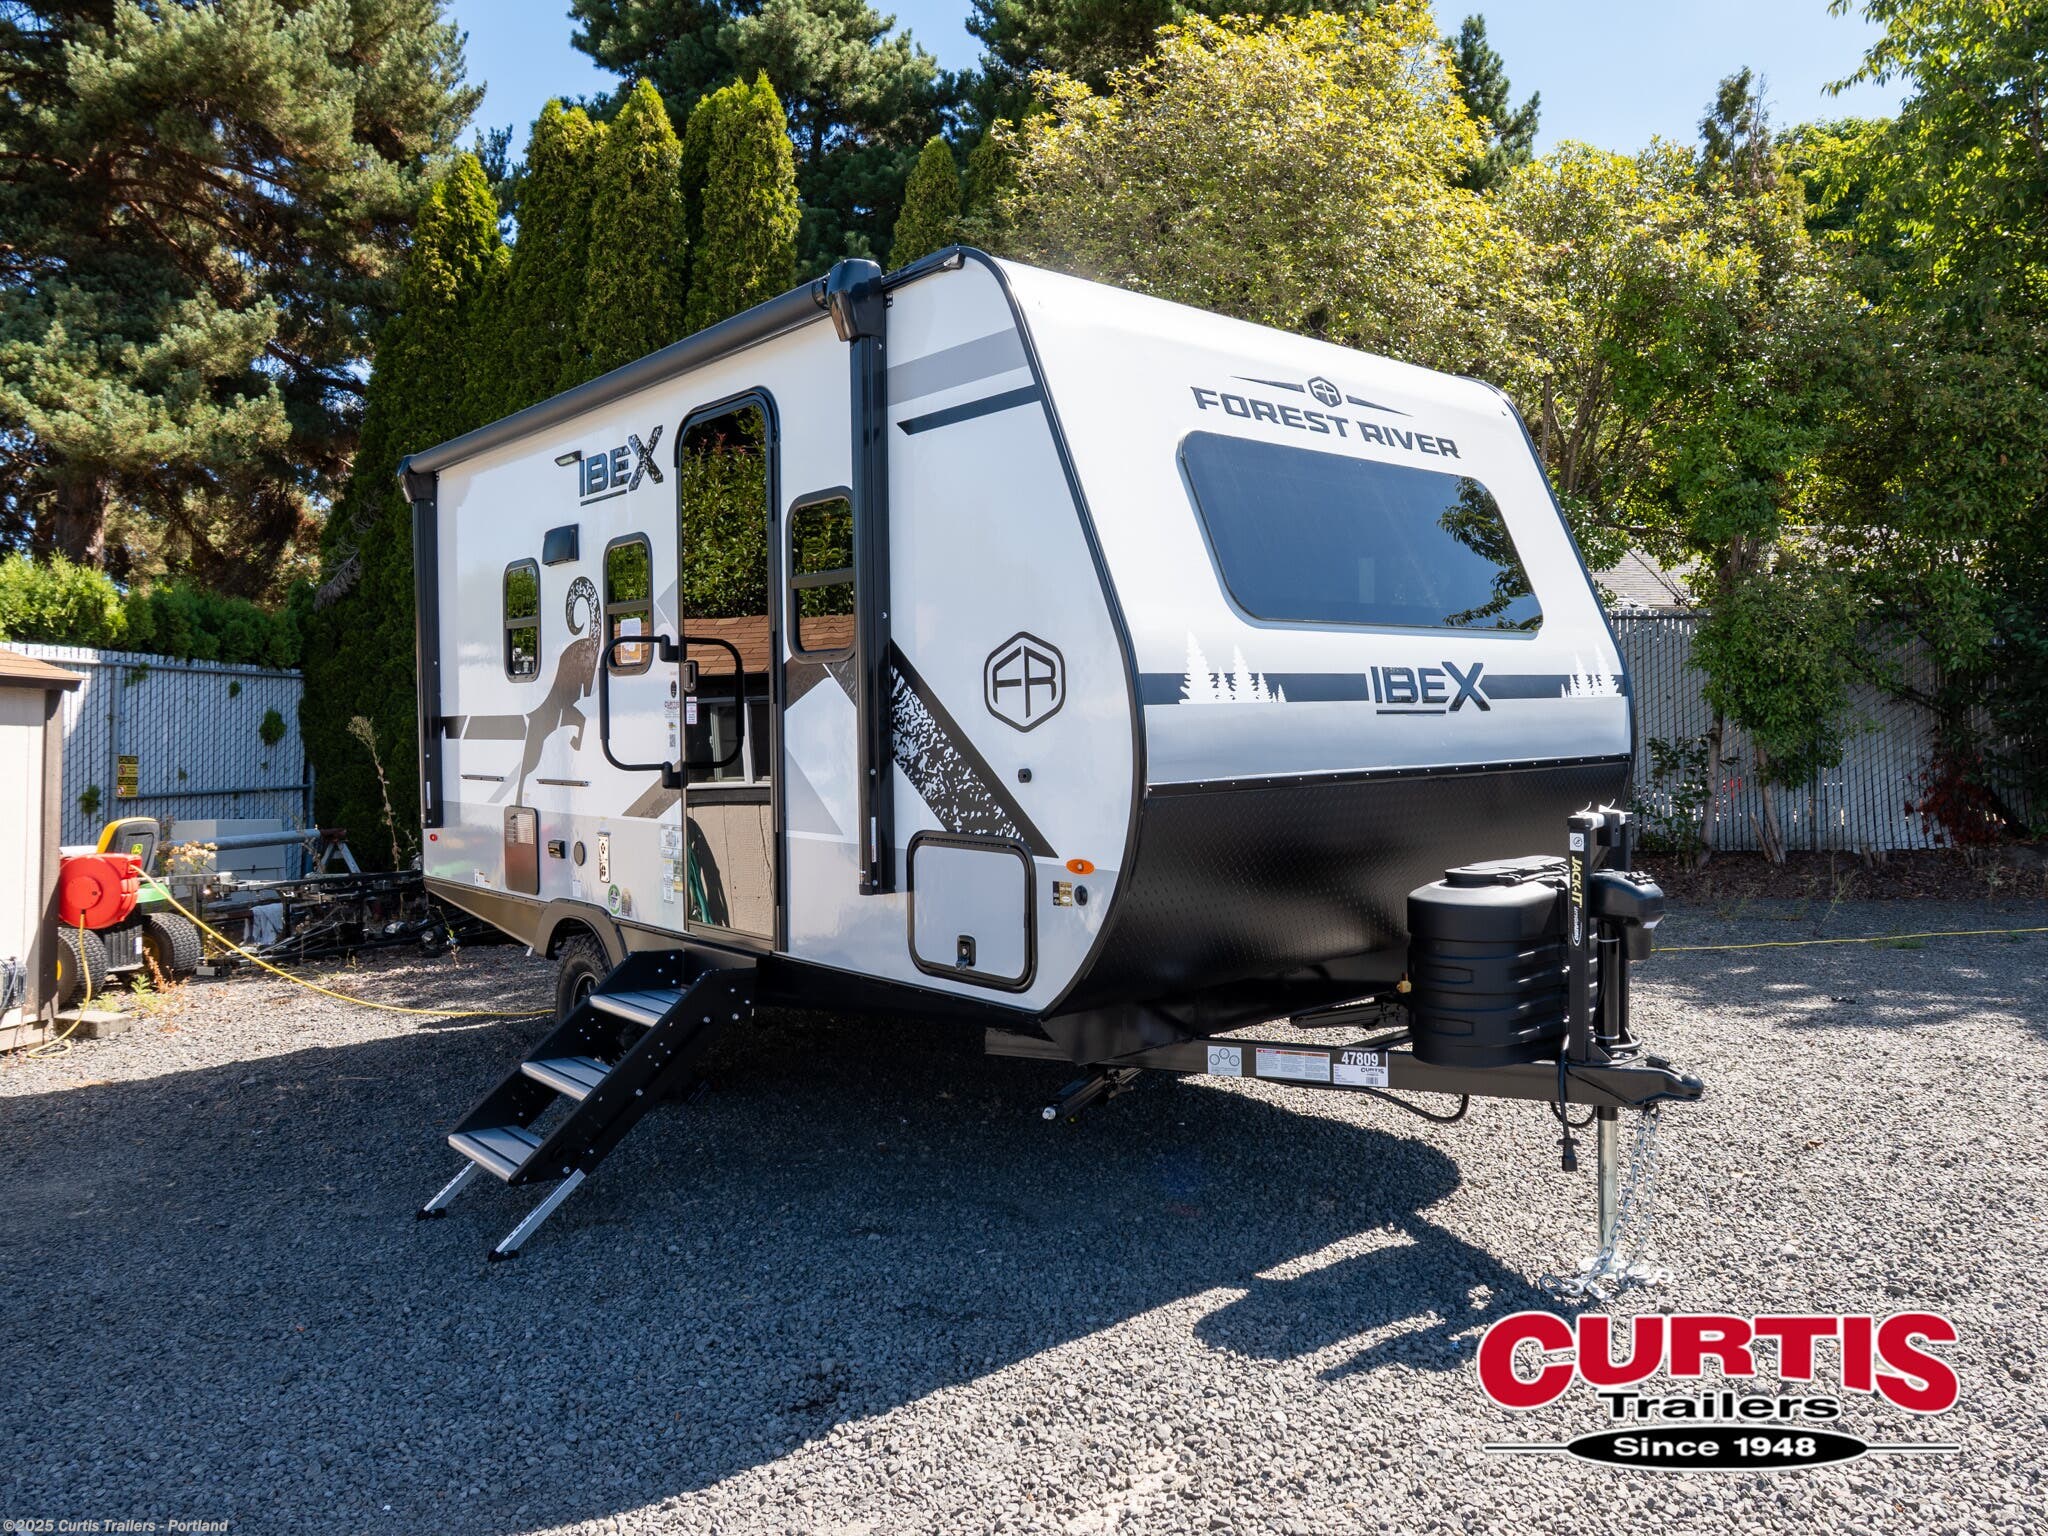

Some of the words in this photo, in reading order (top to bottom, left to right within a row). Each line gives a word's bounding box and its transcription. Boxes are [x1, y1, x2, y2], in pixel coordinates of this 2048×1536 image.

[1190, 386, 1349, 438] FOREST
[1356, 420, 1462, 459] RIVER
[579, 424, 664, 498] IBEX
[1370, 661, 1491, 712] IBEX
[1571, 856, 1583, 907] JACK-IT
[1341, 1051, 1379, 1067] 47809
